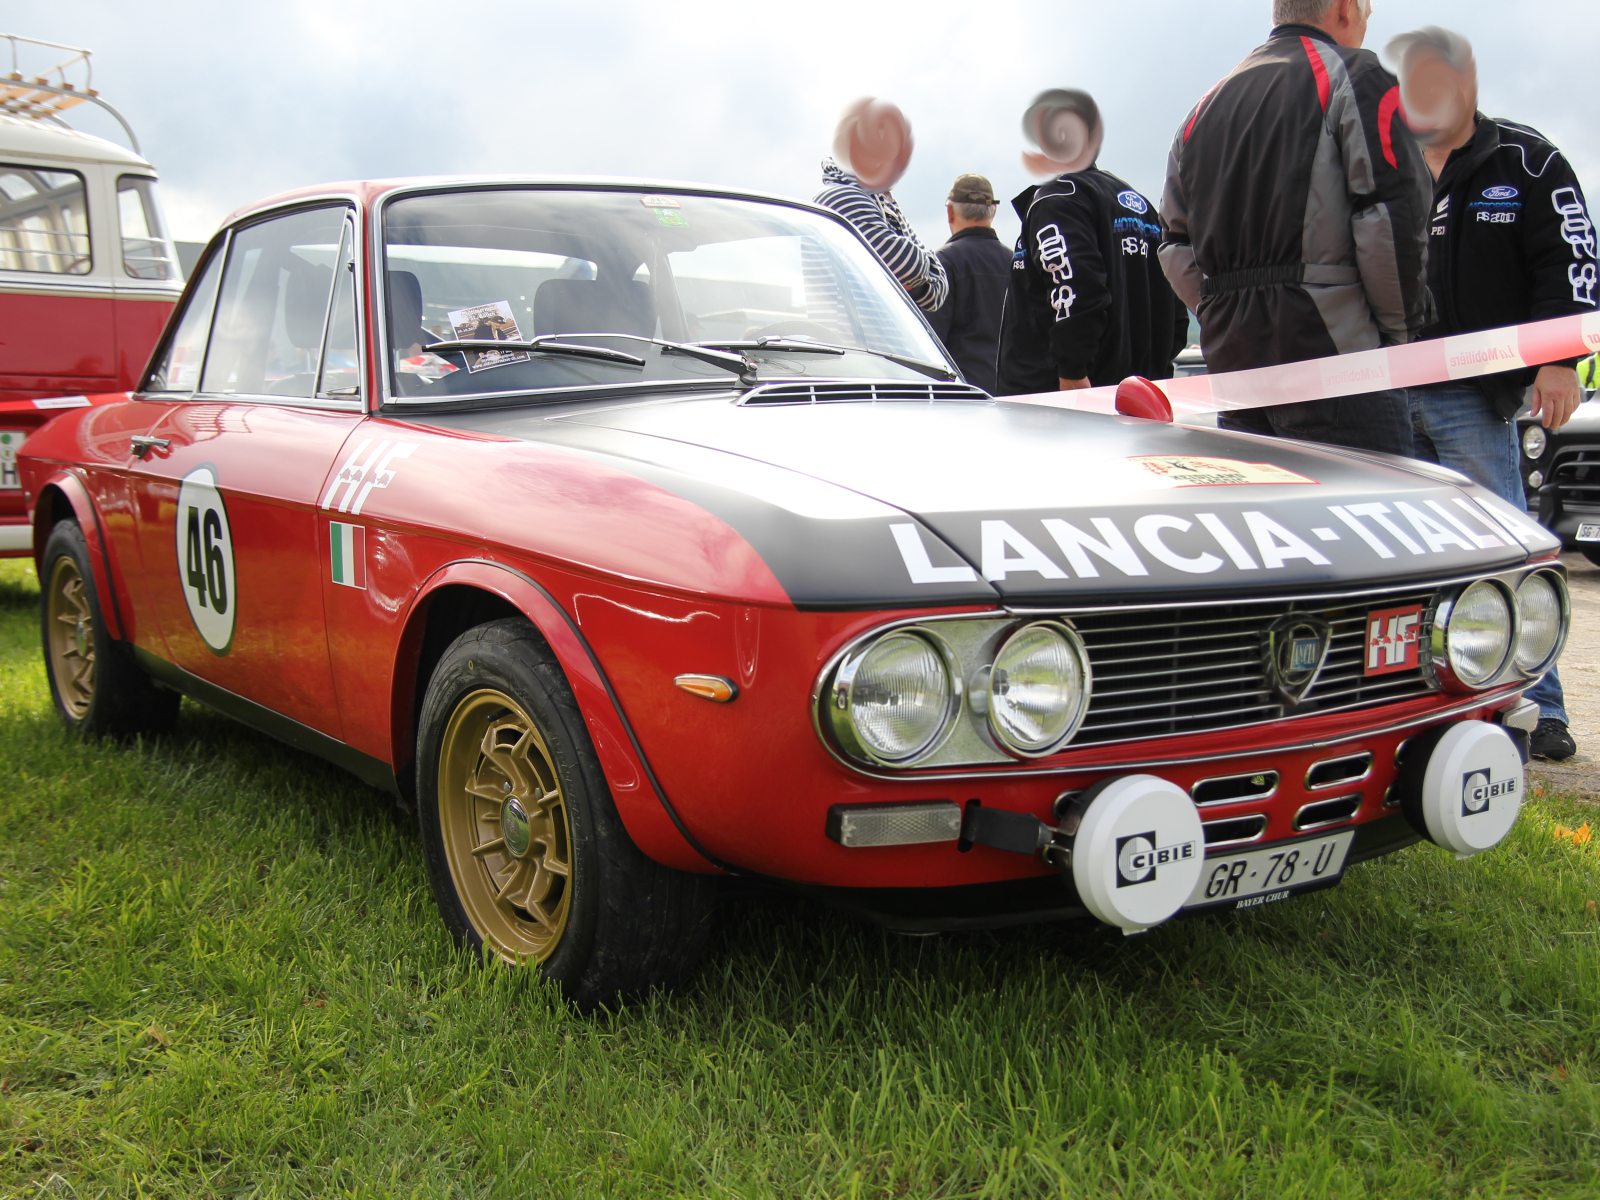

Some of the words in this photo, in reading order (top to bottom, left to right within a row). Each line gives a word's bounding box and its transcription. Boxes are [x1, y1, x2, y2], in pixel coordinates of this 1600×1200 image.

[1125, 193, 1143, 211] Ford
[1489, 188, 1511, 197] Ford
[1476, 211, 1490, 222] RS
[1121, 236, 1139, 256] RS
[321, 438, 421, 515] HF
[187, 505, 228, 615] 46
[1367, 611, 1420, 670] HF
[1236, 896, 1265, 909] BAYER
[1265, 890, 1290, 903] CHUR
